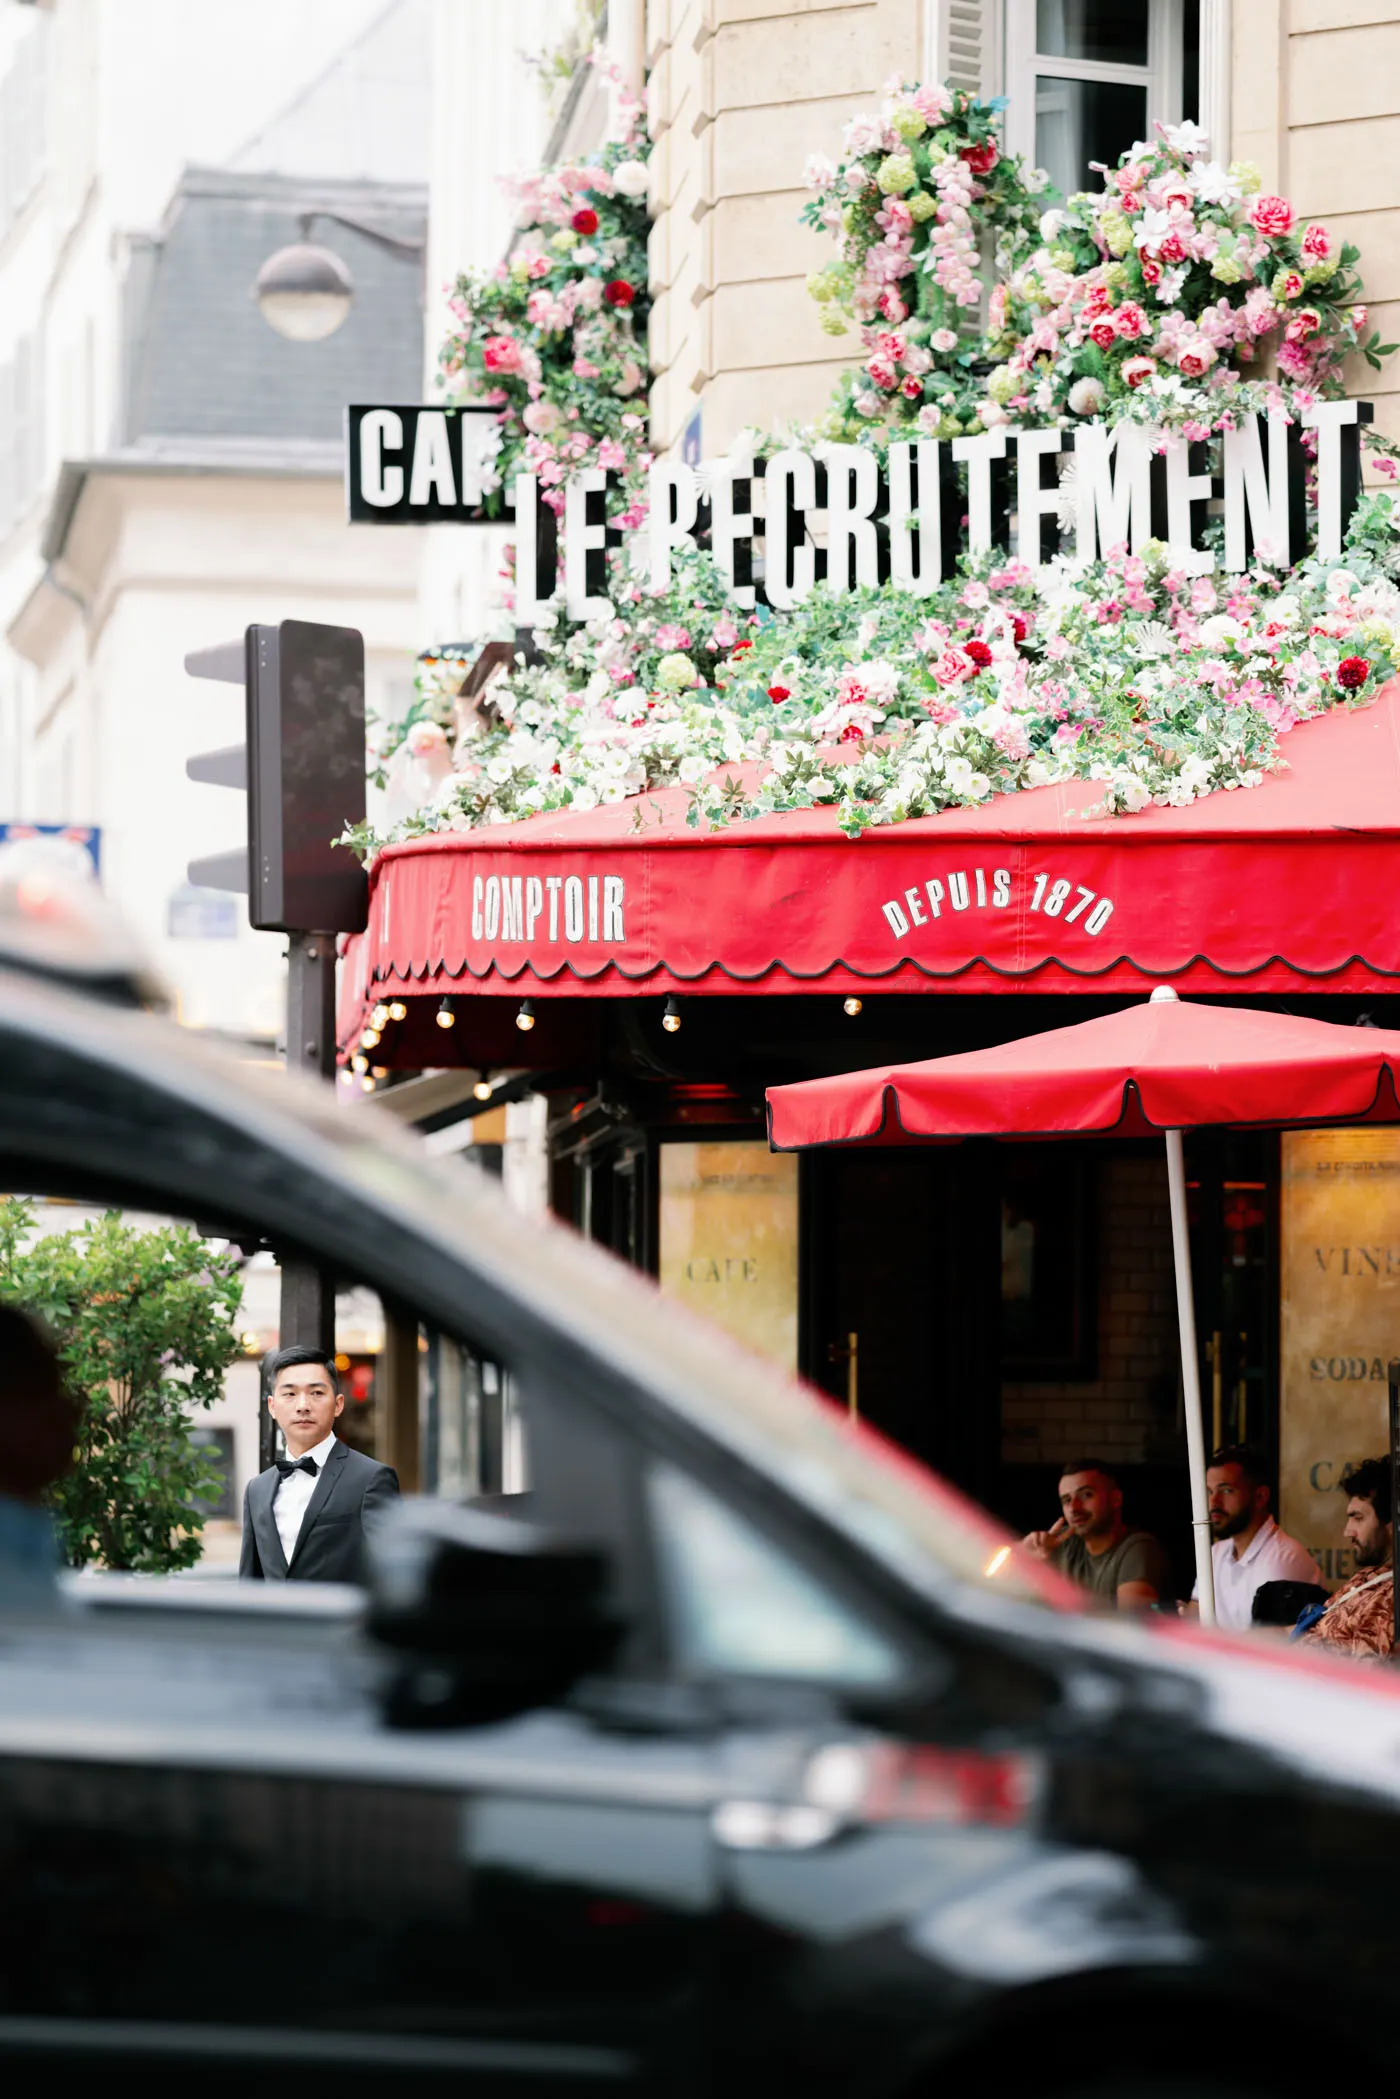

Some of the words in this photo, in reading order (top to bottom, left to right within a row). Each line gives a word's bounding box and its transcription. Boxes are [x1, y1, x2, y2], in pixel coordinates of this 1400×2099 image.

[359, 409, 516, 507] CAF
[515, 468, 614, 628] LE
[650, 399, 1358, 610] RECRUTEMENT
[471, 874, 626, 943] COMPTOIR
[881, 868, 1012, 940] DEPUIS
[1029, 871, 1115, 937] 1870
[1309, 1356, 1386, 1382] SODA
